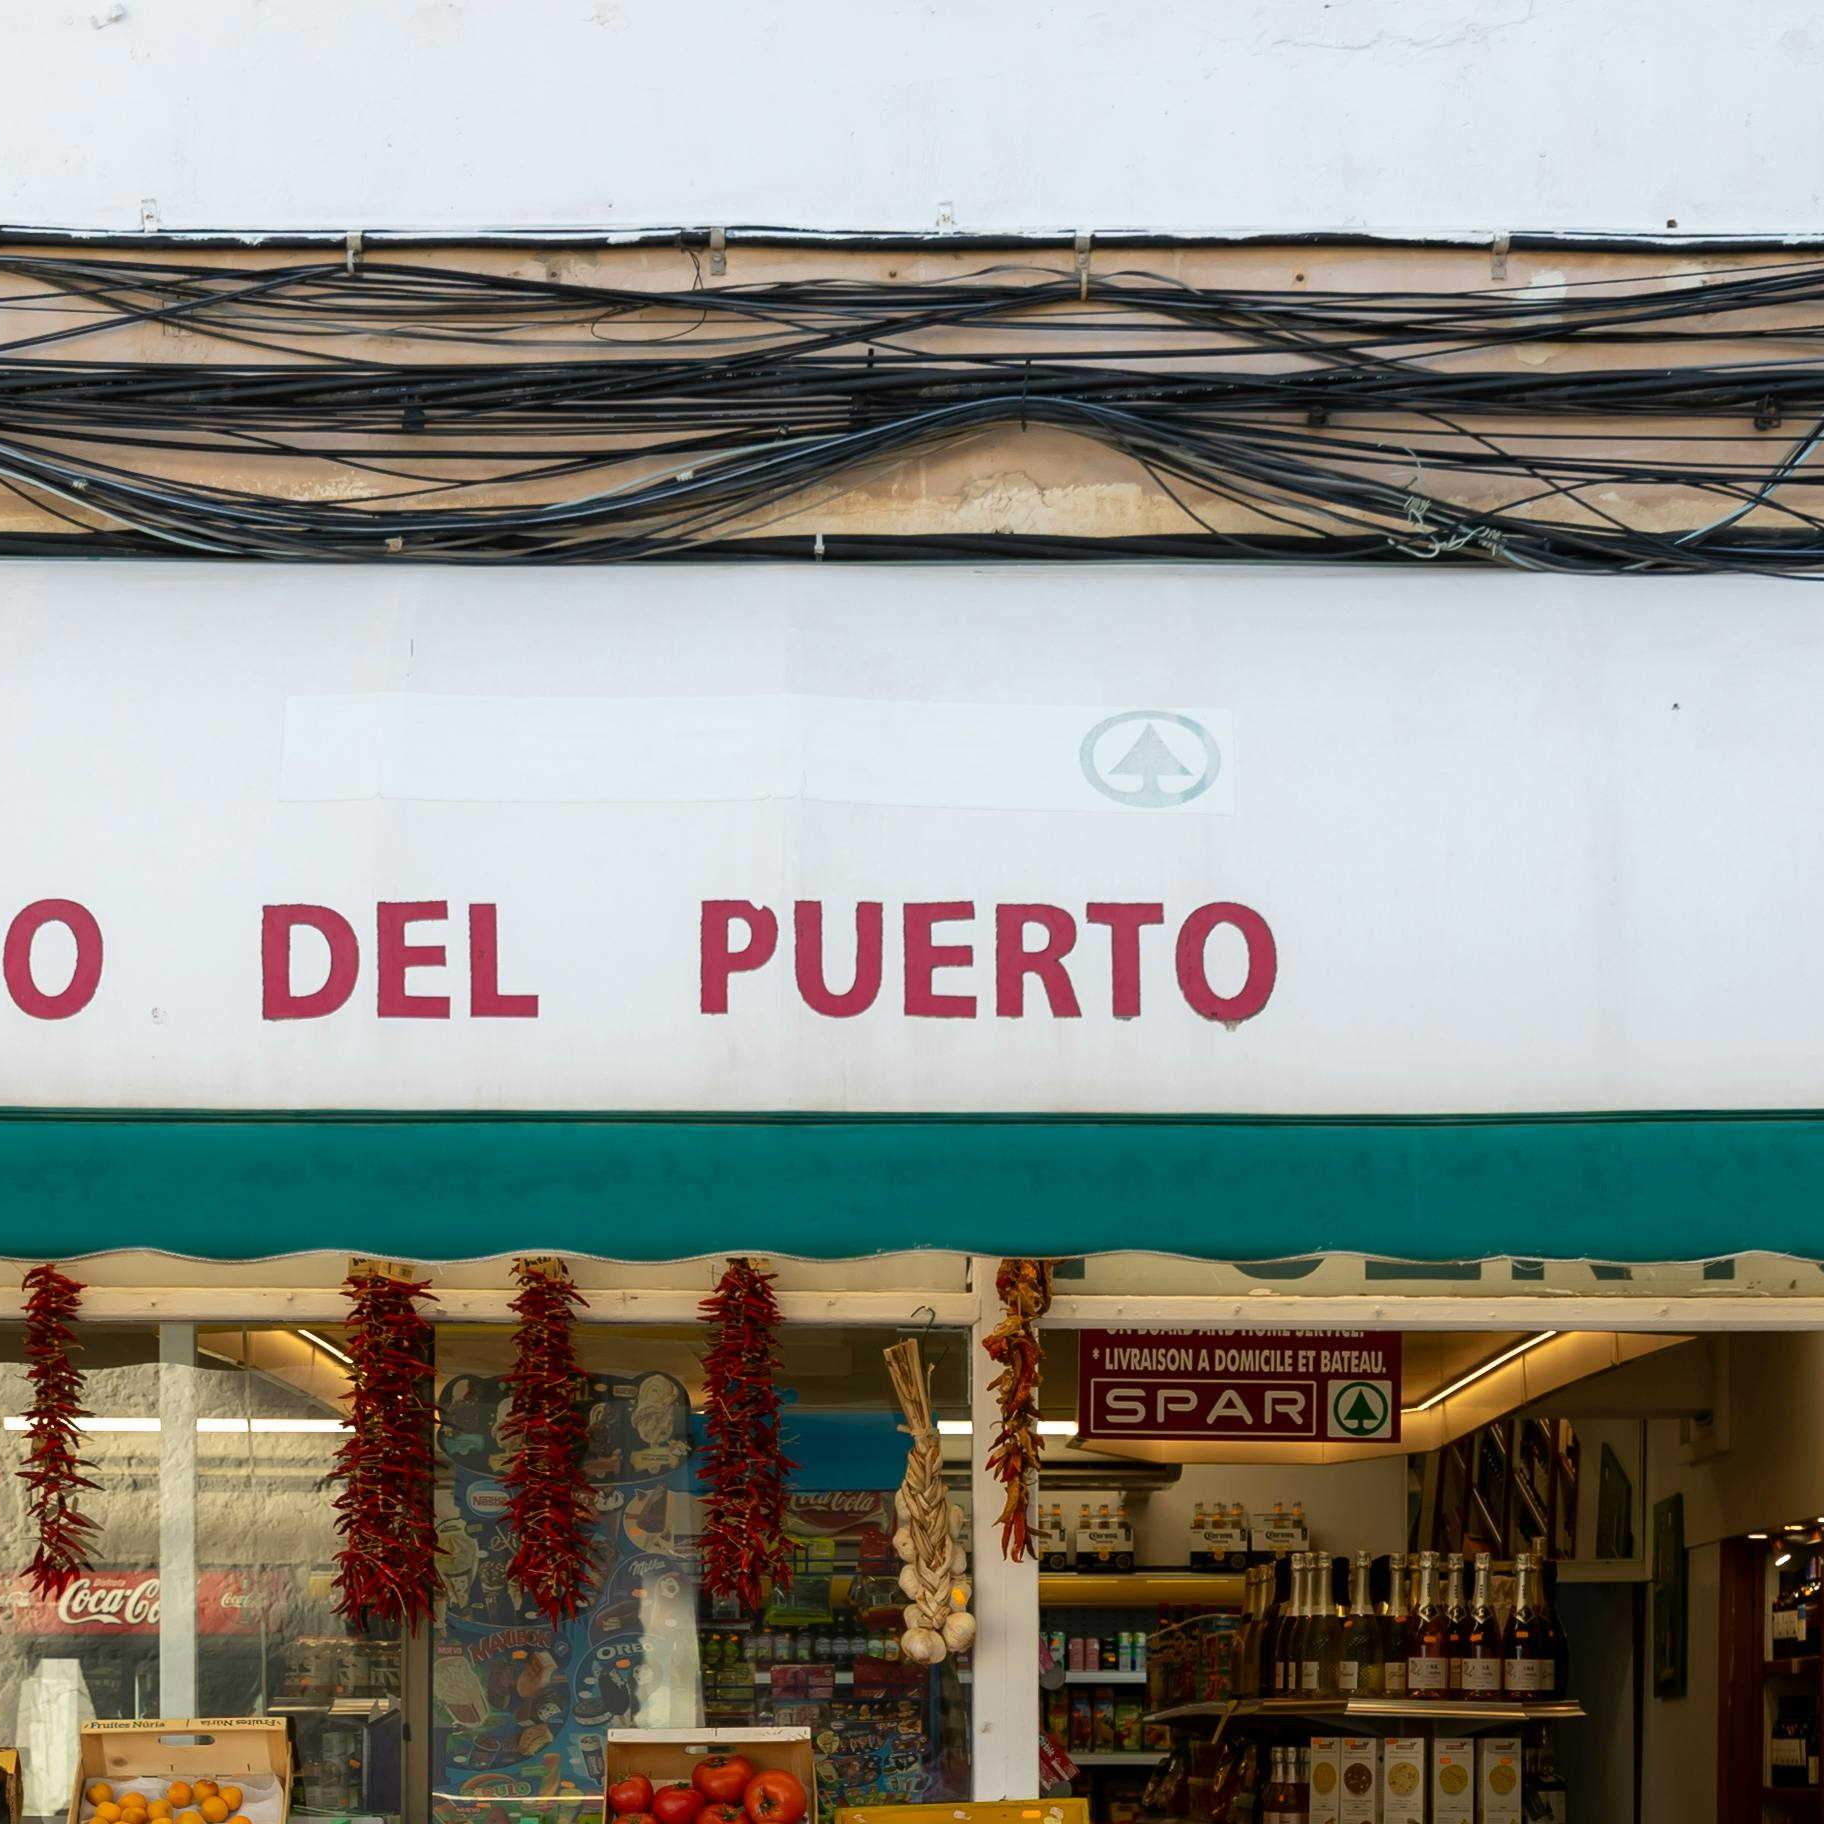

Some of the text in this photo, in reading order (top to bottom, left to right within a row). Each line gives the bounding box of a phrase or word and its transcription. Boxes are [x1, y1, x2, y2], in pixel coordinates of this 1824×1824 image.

[263, 900, 538, 1018] DEL
[701, 899, 1275, 1022] PUERTO
[1104, 1348, 1387, 1375] LIVRAISON A DOMICILE ET BATEAU.
[1104, 1387, 1306, 1425] SPAR
[596, 1643, 653, 1661] OREO
